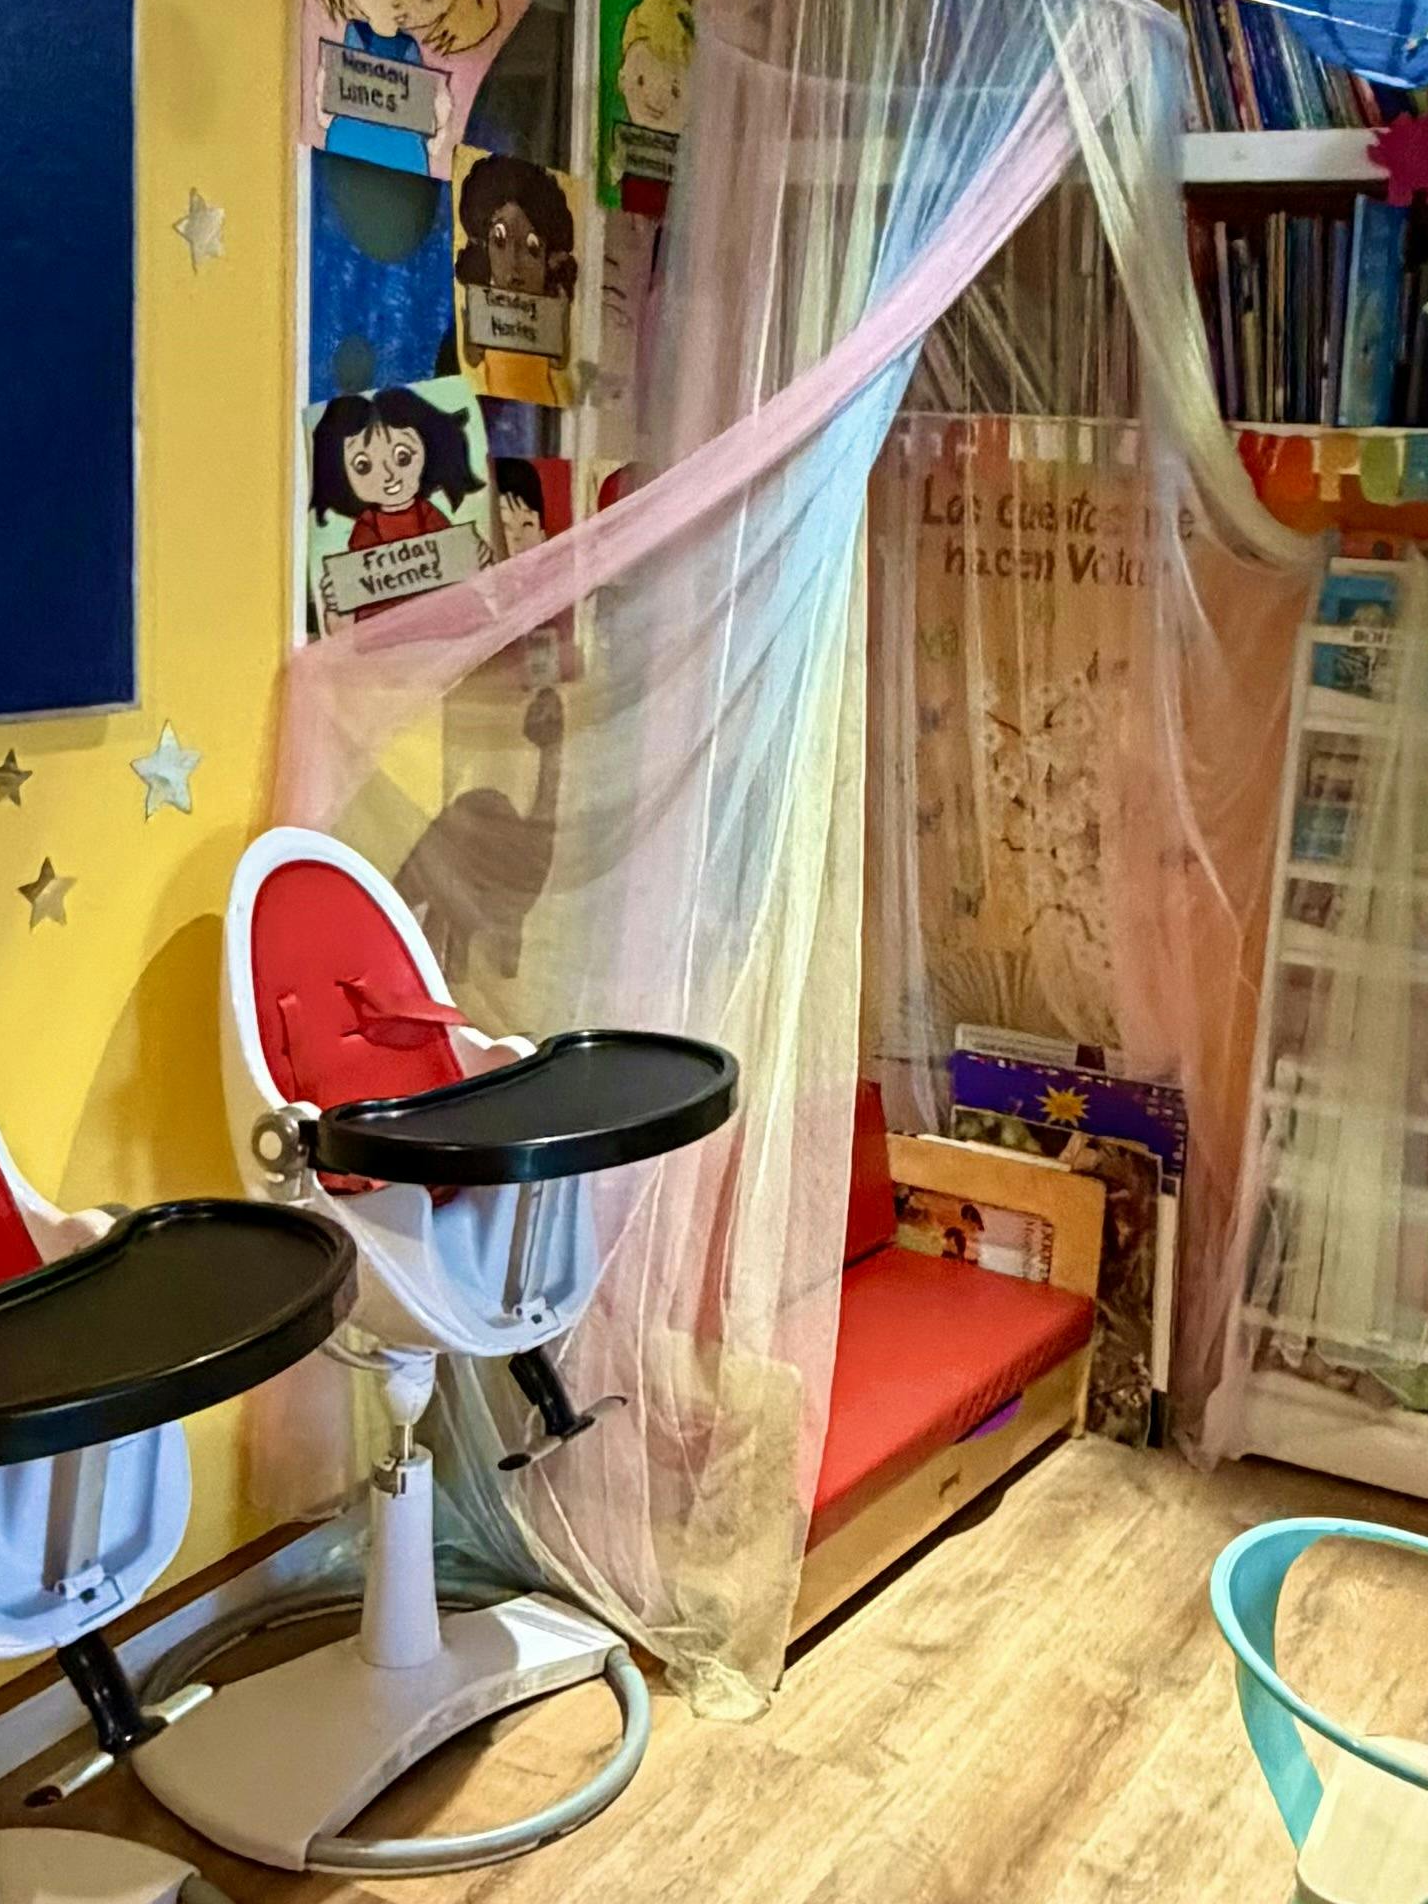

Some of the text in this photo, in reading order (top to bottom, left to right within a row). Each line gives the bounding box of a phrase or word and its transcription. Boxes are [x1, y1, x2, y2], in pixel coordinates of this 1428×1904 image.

[341, 50, 410, 100] Monday
[338, 75, 399, 113] Lunes
[363, 540, 441, 570] Friday
[359, 560, 444, 595] Viernes
